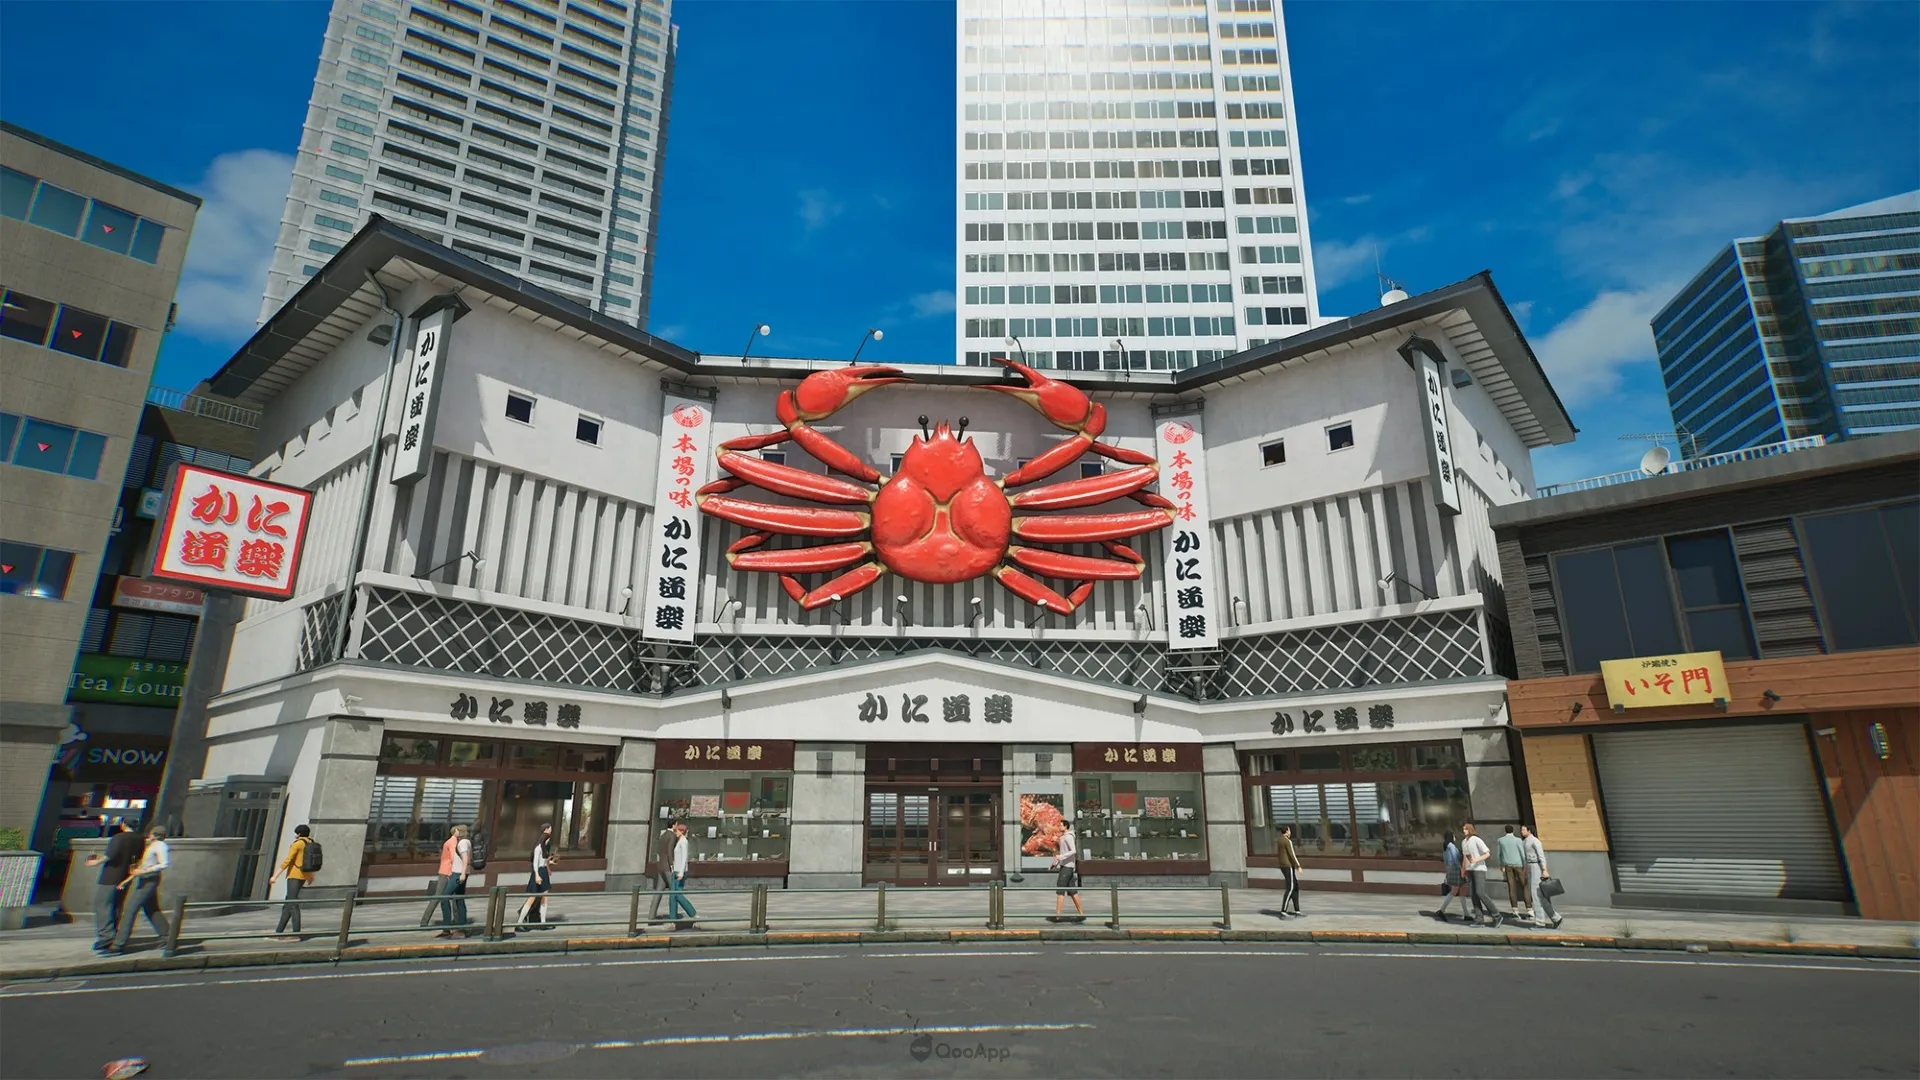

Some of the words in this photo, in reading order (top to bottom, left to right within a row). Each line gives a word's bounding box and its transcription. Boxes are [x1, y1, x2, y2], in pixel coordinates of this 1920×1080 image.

[668, 433, 697, 509] 本場の味
[1168, 450, 1196, 522] 本場の味
[190, 483, 291, 538] かに
[68, 672, 109, 691] Tea
[1624, 666, 1712, 696] いそ門
[87, 747, 164, 766] SNOW
